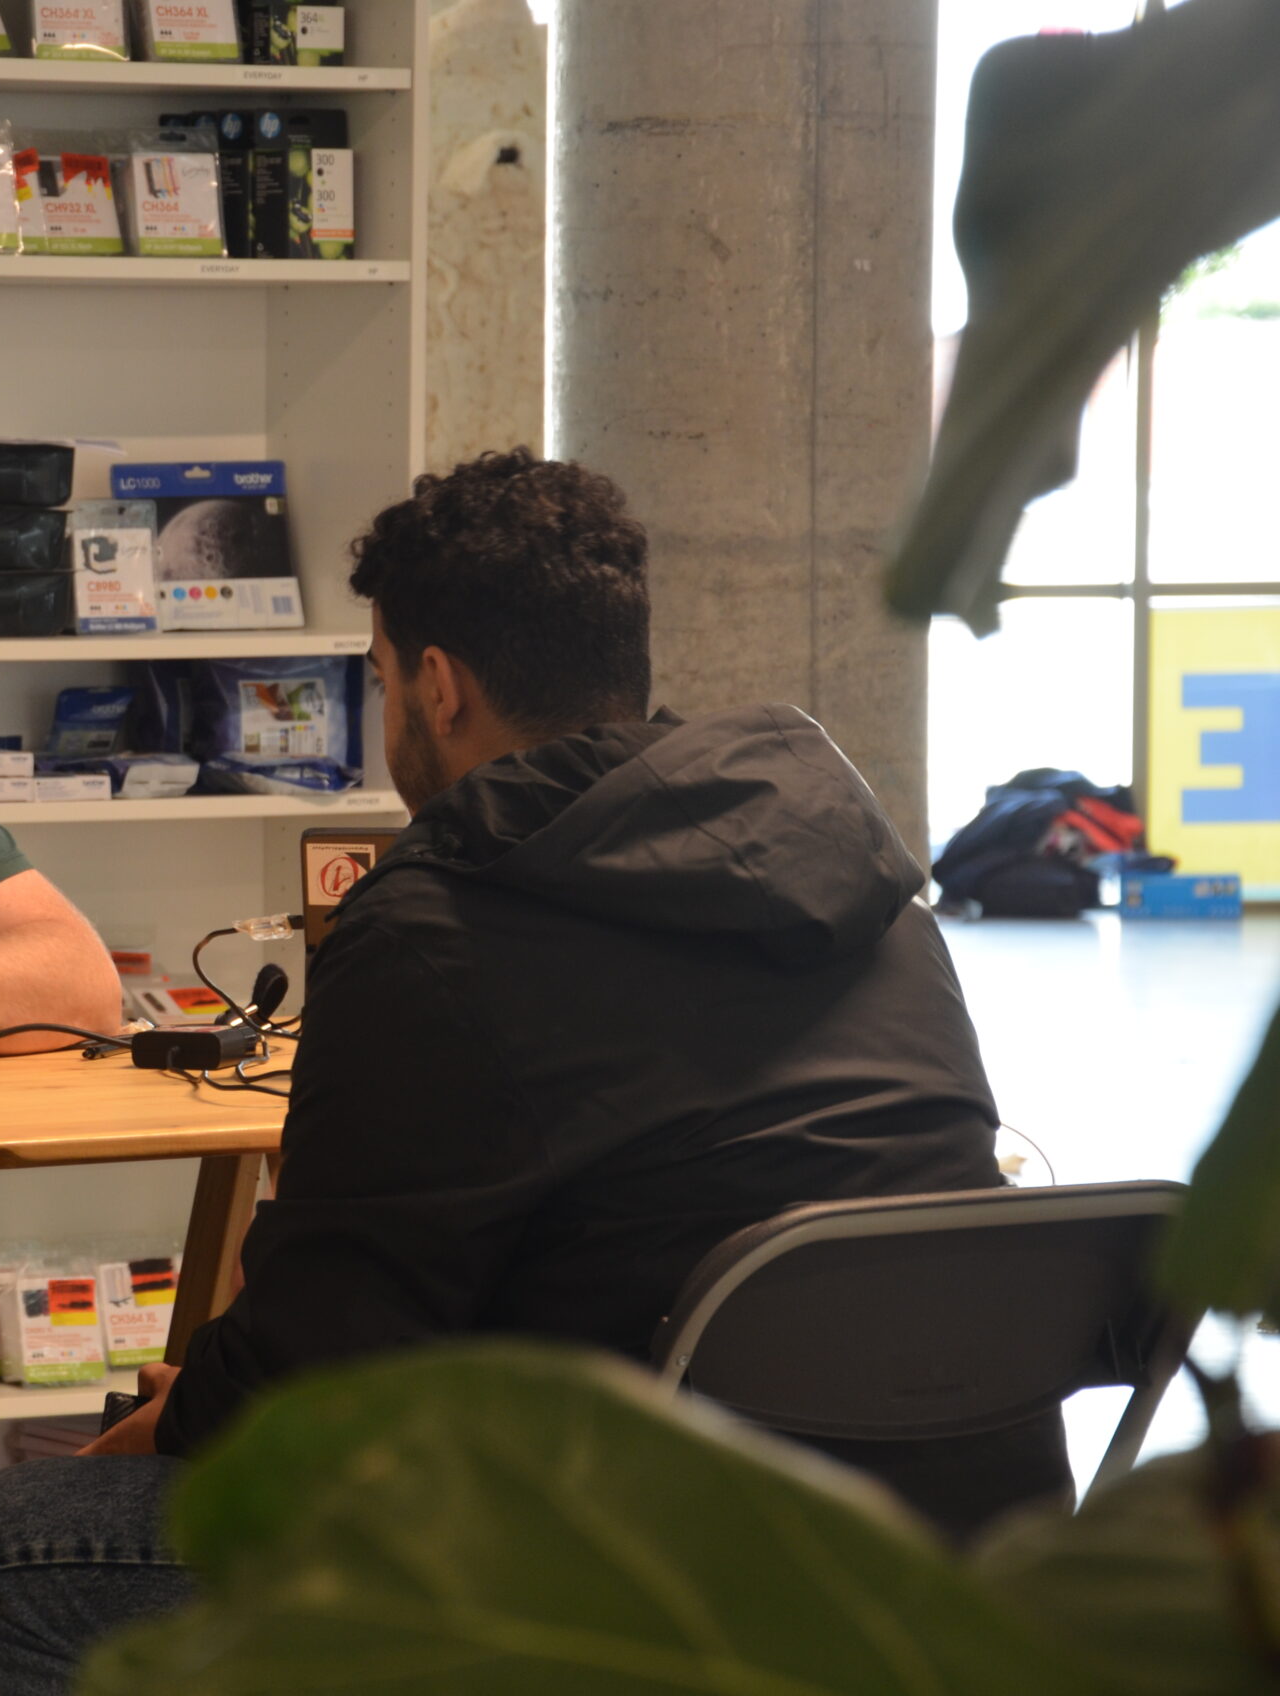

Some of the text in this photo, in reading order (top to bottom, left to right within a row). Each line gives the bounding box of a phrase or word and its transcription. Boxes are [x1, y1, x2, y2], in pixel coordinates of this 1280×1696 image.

[41, 7, 96, 20] CH364 XL
[156, 6, 209, 17] CH364 XL
[243, 71, 282, 80] EVERYDAY
[316, 154, 335, 166] 300
[317, 190, 335, 202] 300
[45, 202, 96, 214] CH932 XL
[142, 201, 179, 212] CH364
[201, 265, 240, 273] EVERYDAY
[120, 477, 160, 489] LC1000
[233, 472, 273, 485] brother
